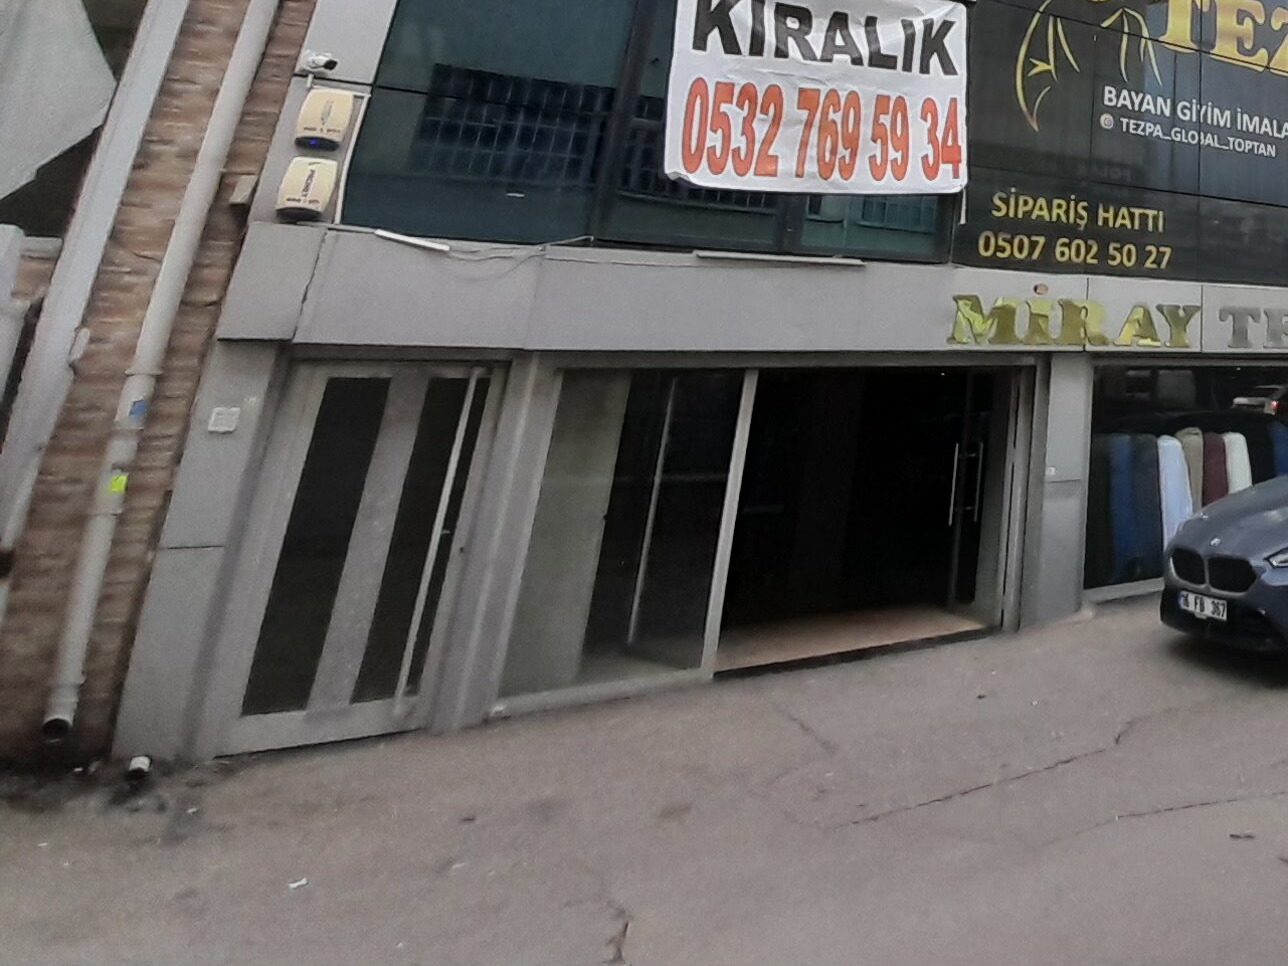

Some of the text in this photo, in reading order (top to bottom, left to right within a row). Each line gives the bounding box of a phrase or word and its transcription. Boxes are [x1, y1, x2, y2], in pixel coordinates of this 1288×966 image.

[681, 77, 962, 181] 0532 769 59 34
[1103, 86, 1171, 117] BAYAN
[1177, 99, 1231, 129] GİYİM
[991, 187, 1164, 233] SİPARİŞ HATTI
[978, 230, 1172, 269] 0507 602 50 27
